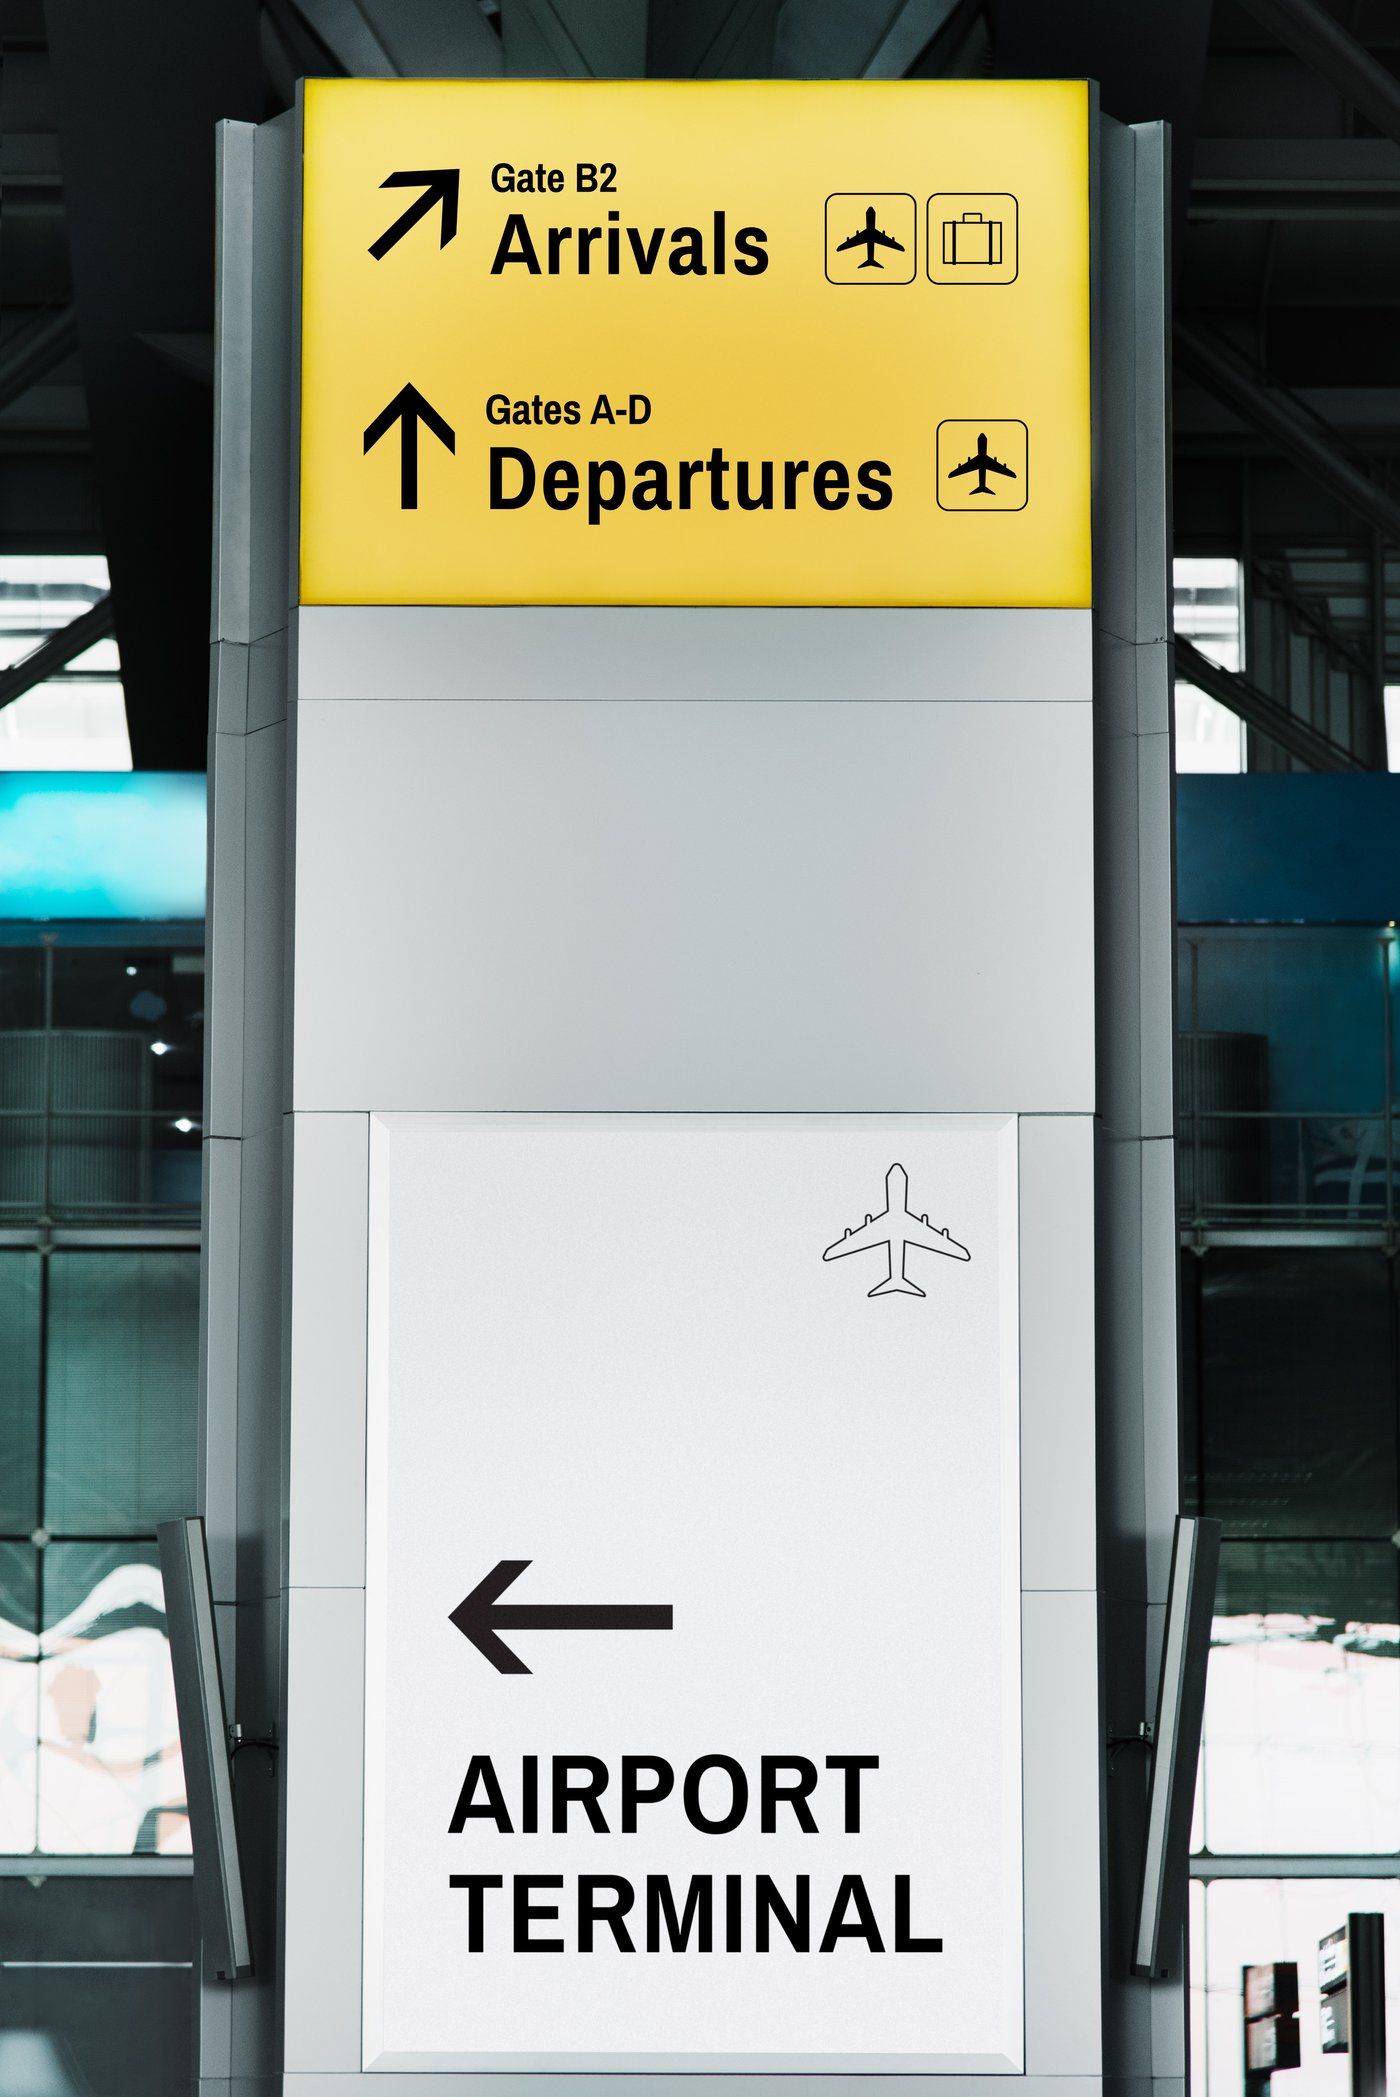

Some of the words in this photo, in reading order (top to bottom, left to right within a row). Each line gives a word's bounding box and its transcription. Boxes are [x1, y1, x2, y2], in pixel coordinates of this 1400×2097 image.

[491, 162, 565, 193] Gate
[576, 162, 617, 193] B2
[490, 210, 769, 276] Arrivals
[485, 393, 581, 425] Gates
[590, 394, 652, 425] A-D
[489, 446, 893, 526] Departures
[447, 1753, 880, 1835] AIRPORT
[449, 1874, 943, 1953] TERMINAL
